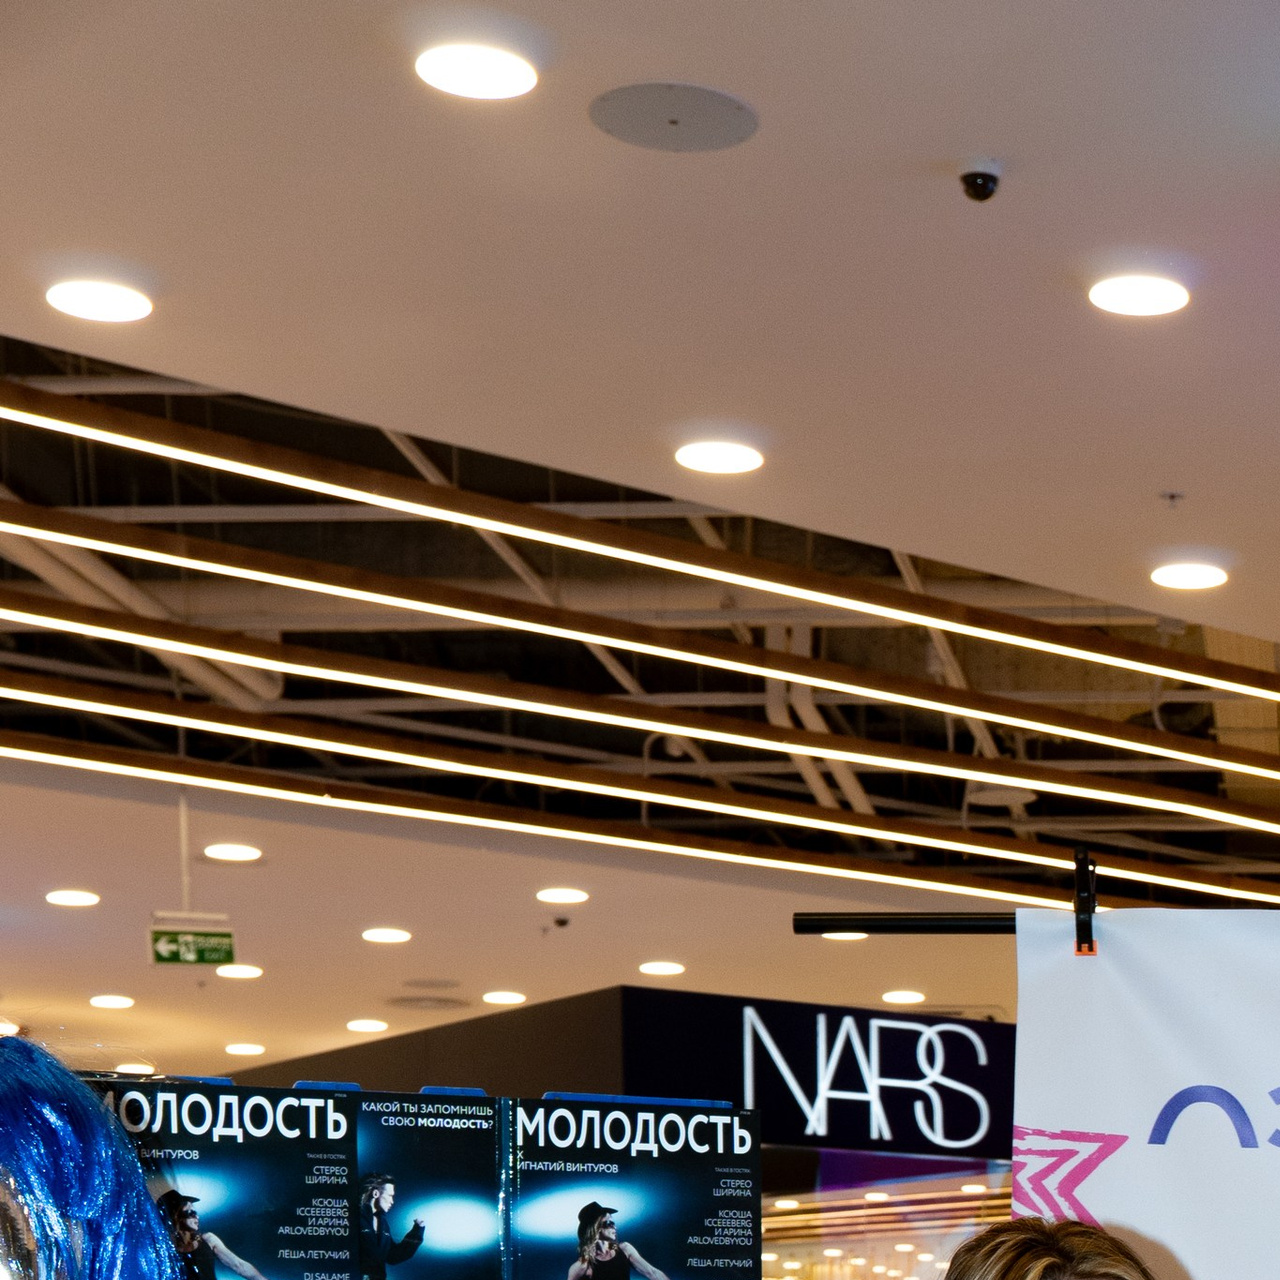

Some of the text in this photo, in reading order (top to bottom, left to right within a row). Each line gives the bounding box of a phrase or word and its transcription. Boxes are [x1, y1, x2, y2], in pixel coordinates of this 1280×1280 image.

[743, 1006, 990, 1149] NARS
[362, 1101, 493, 1116] КАКОЙ ТЫ ЗАПОМНИШЬ
[105, 1090, 348, 1143] ОЛОДОСТЬ
[381, 1116, 494, 1130] СВОЮ МОЛОДОСТЬ?
[516, 1107, 752, 1158] МОЛОДОСТЬ
[313, 1166, 348, 1176] СТЕРЕО
[517, 1160, 618, 1174] ИГНАТИЙ ВИНТУРОВ
[305, 1176, 348, 1185] ШИРИНА
[720, 1179, 752, 1188] СТЕРЕО
[713, 1188, 752, 1197] ШИРИНА
[312, 1199, 349, 1208] КСЮША
[719, 1210, 752, 1218] КСЮША
[317, 1218, 349, 1227] АРИНА
[722, 1228, 752, 1237] АРИНА
[307, 1249, 350, 1260] ЛЕТУЧИЙ
[713, 1259, 753, 1268] ЛЕТУЧИЙ
